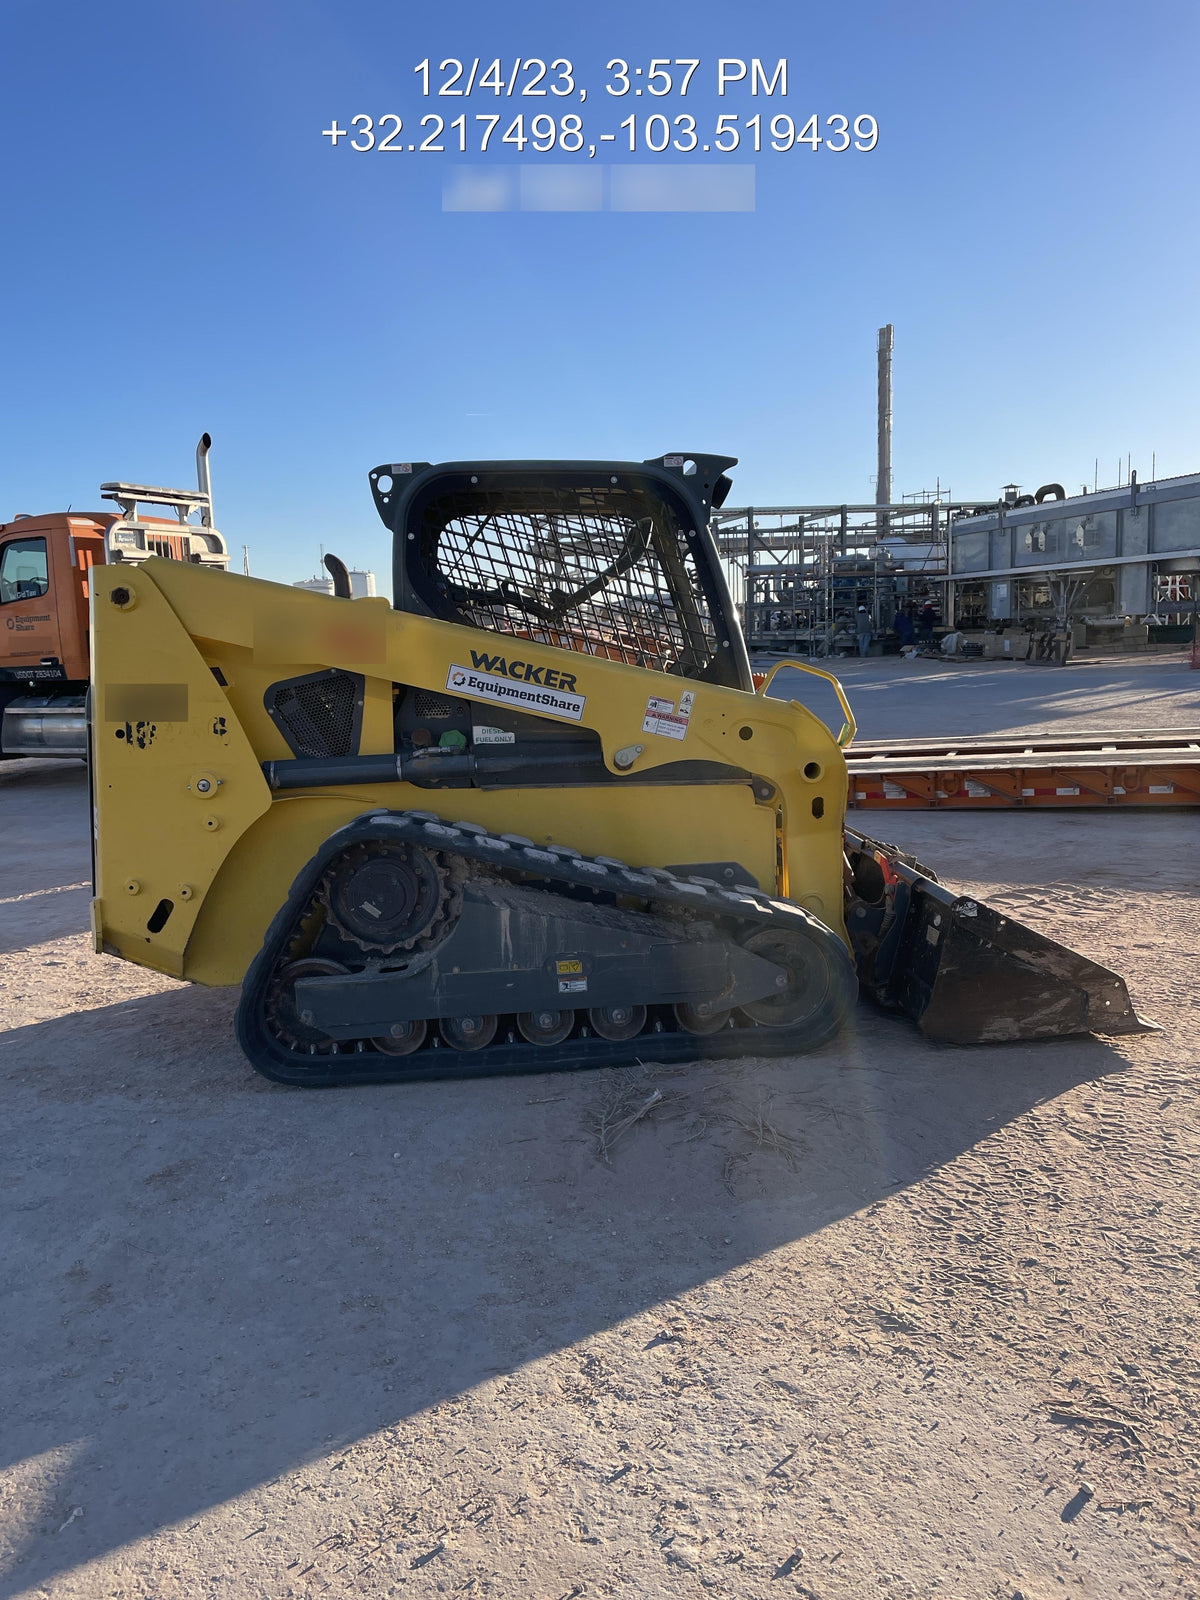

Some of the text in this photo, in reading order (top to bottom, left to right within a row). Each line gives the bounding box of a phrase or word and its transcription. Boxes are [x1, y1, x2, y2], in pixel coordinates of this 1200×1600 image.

[15, 614, 51, 623] Equipment
[15, 670, 34, 679] USDOT
[470, 649, 578, 693] WACKER
[467, 676, 581, 713] EquipmentShare
[494, 735, 513, 743] ONLY
